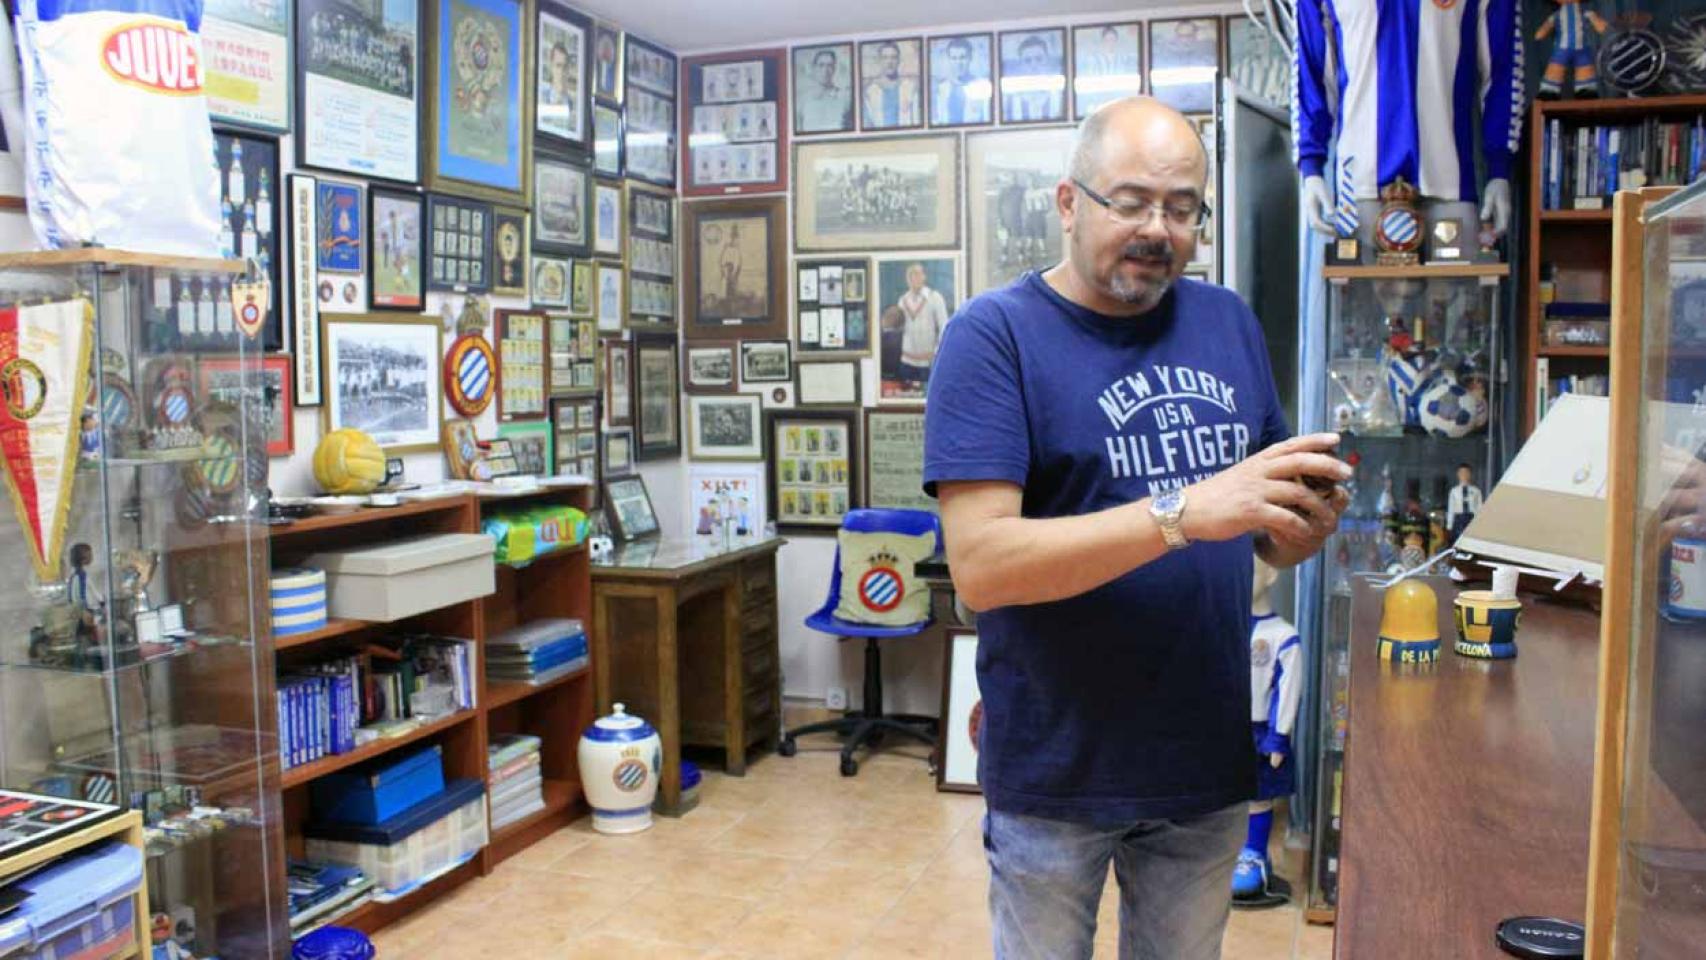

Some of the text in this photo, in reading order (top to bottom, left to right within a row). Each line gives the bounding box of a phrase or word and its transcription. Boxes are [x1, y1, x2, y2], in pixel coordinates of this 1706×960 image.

[108, 27, 201, 87] JUVE
[1097, 365, 1237, 431] NEW YORK
[1153, 402, 1196, 431] USA
[1105, 423, 1250, 479] HILFIGER
[1401, 649, 1416, 663] DE
